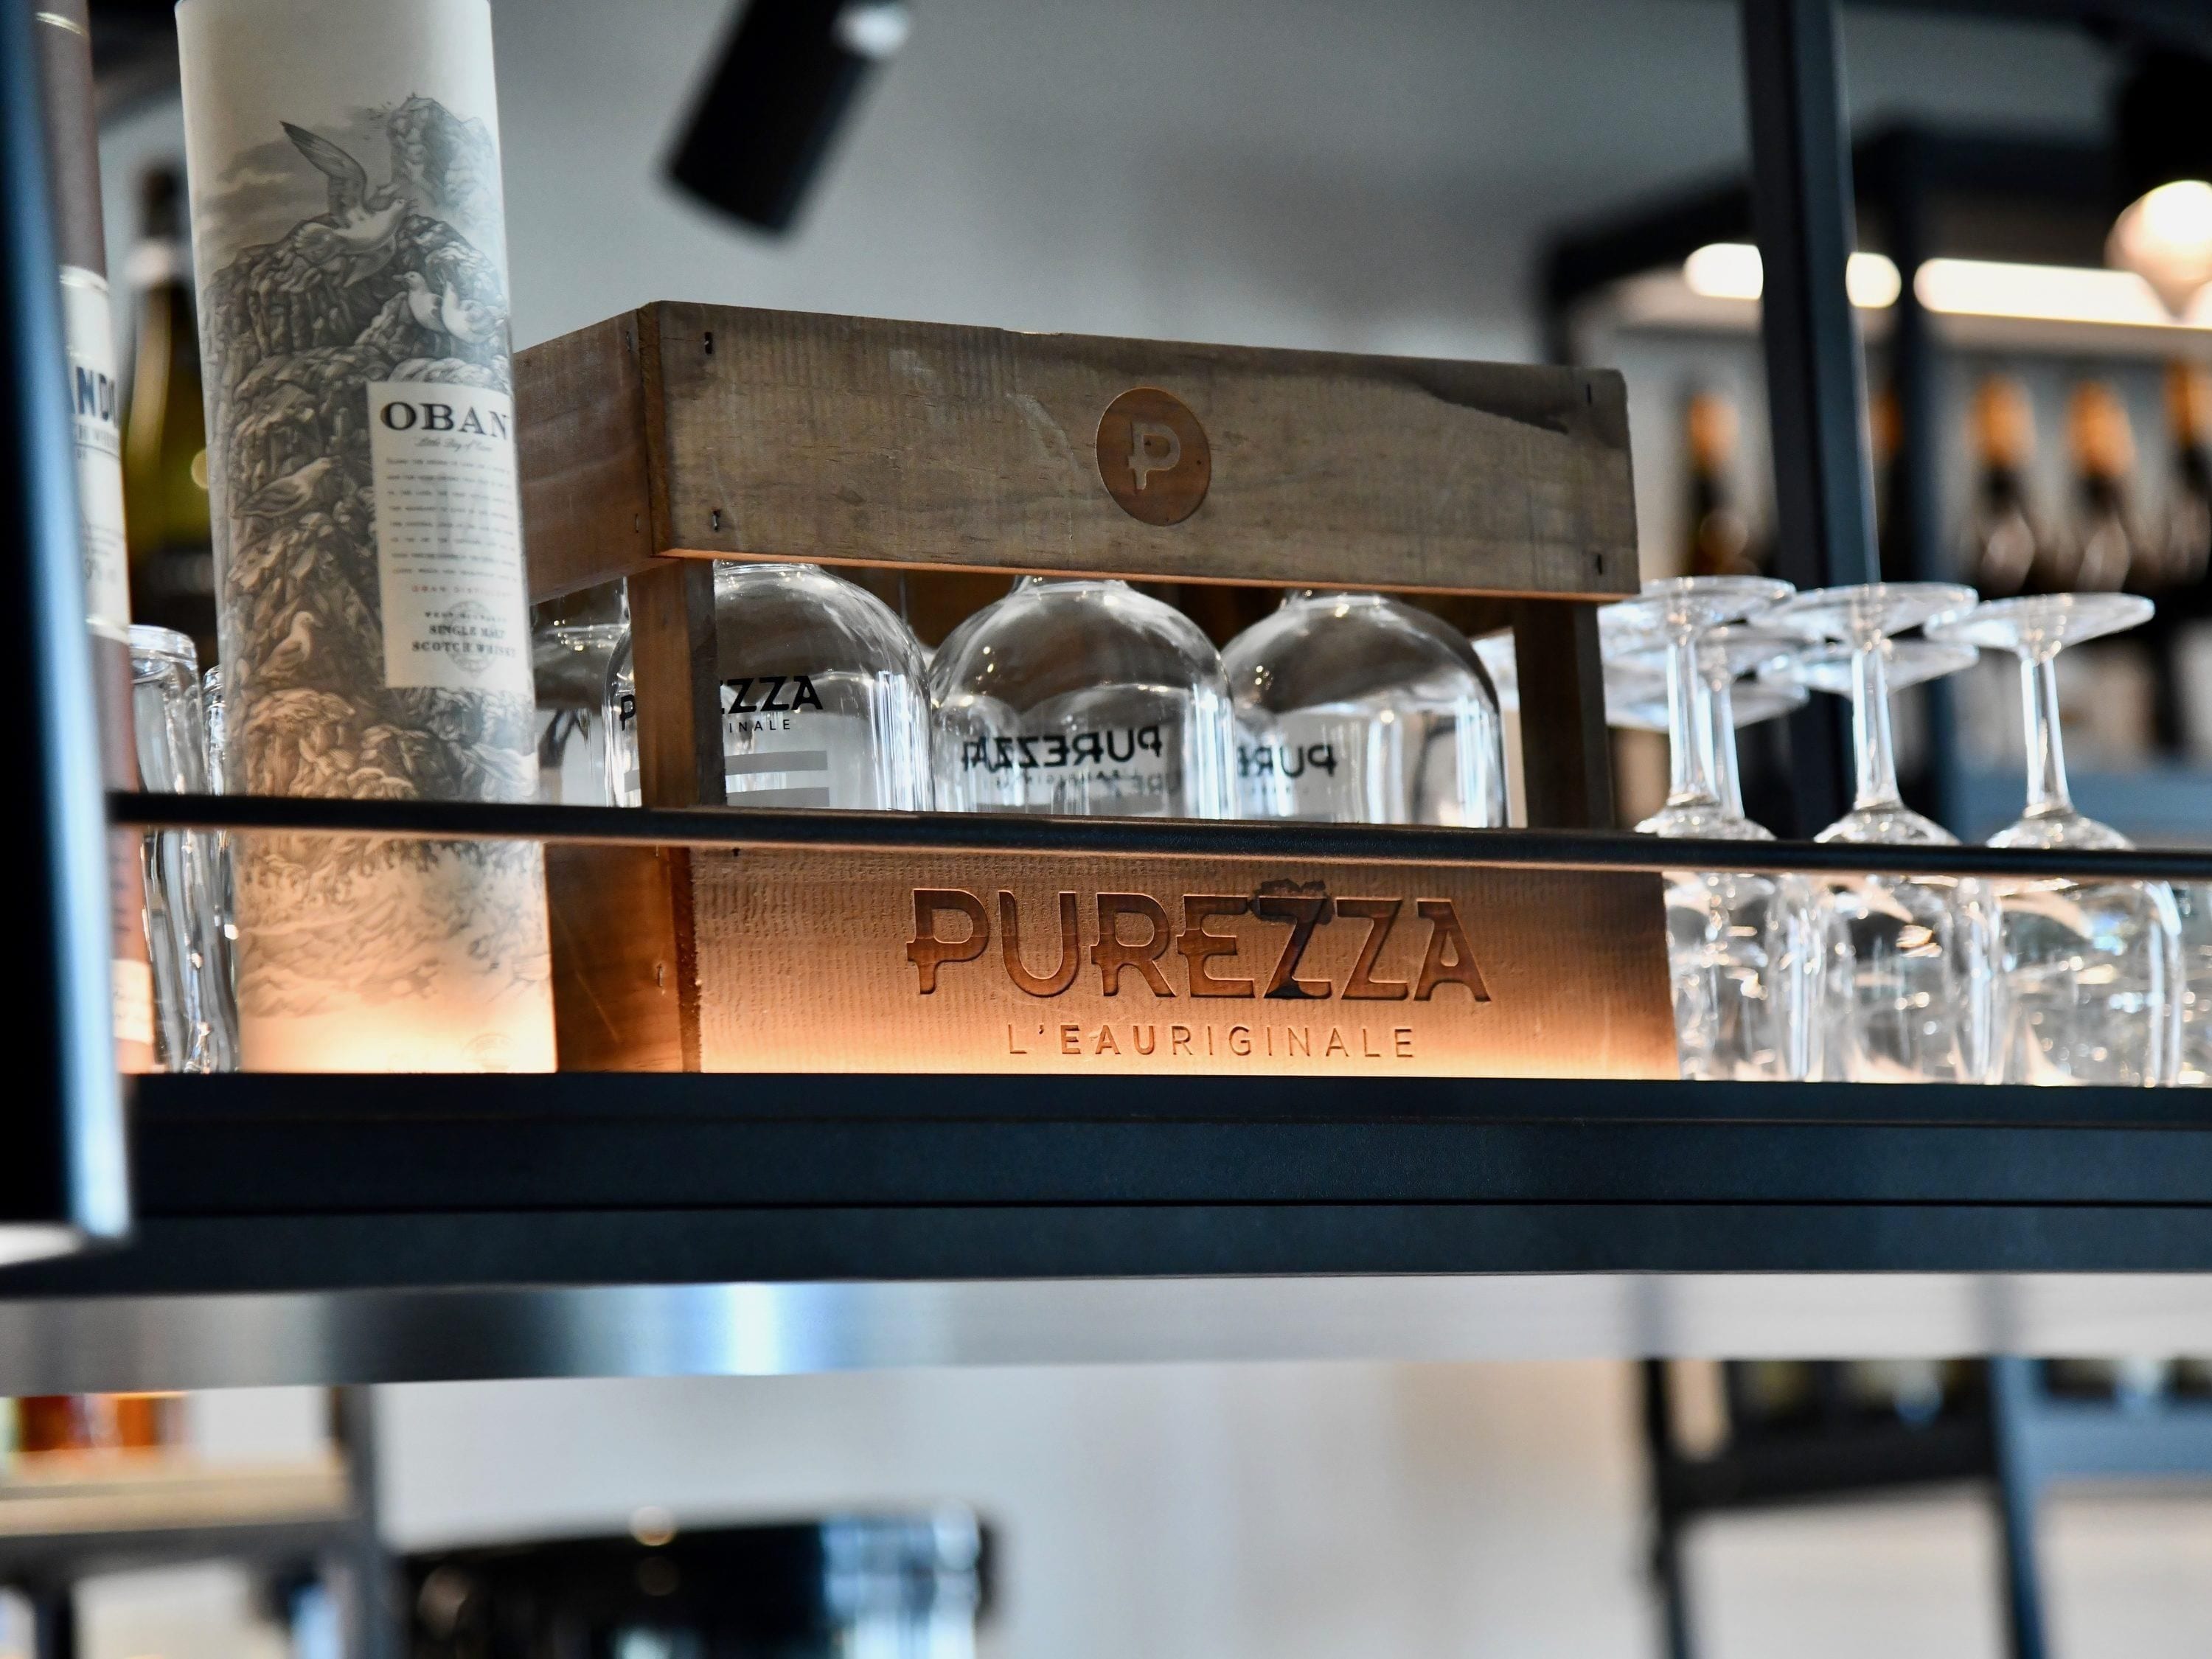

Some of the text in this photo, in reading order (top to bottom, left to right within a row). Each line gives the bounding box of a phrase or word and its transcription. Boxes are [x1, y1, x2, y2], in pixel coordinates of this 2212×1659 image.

[379, 401, 509, 441] OBAN
[1128, 420, 1180, 490] P
[411, 640, 471, 653] SCOTCH
[906, 888, 1491, 1002] PUREZZA
[1007, 1023, 1414, 1058] L'EAURIGINALE
